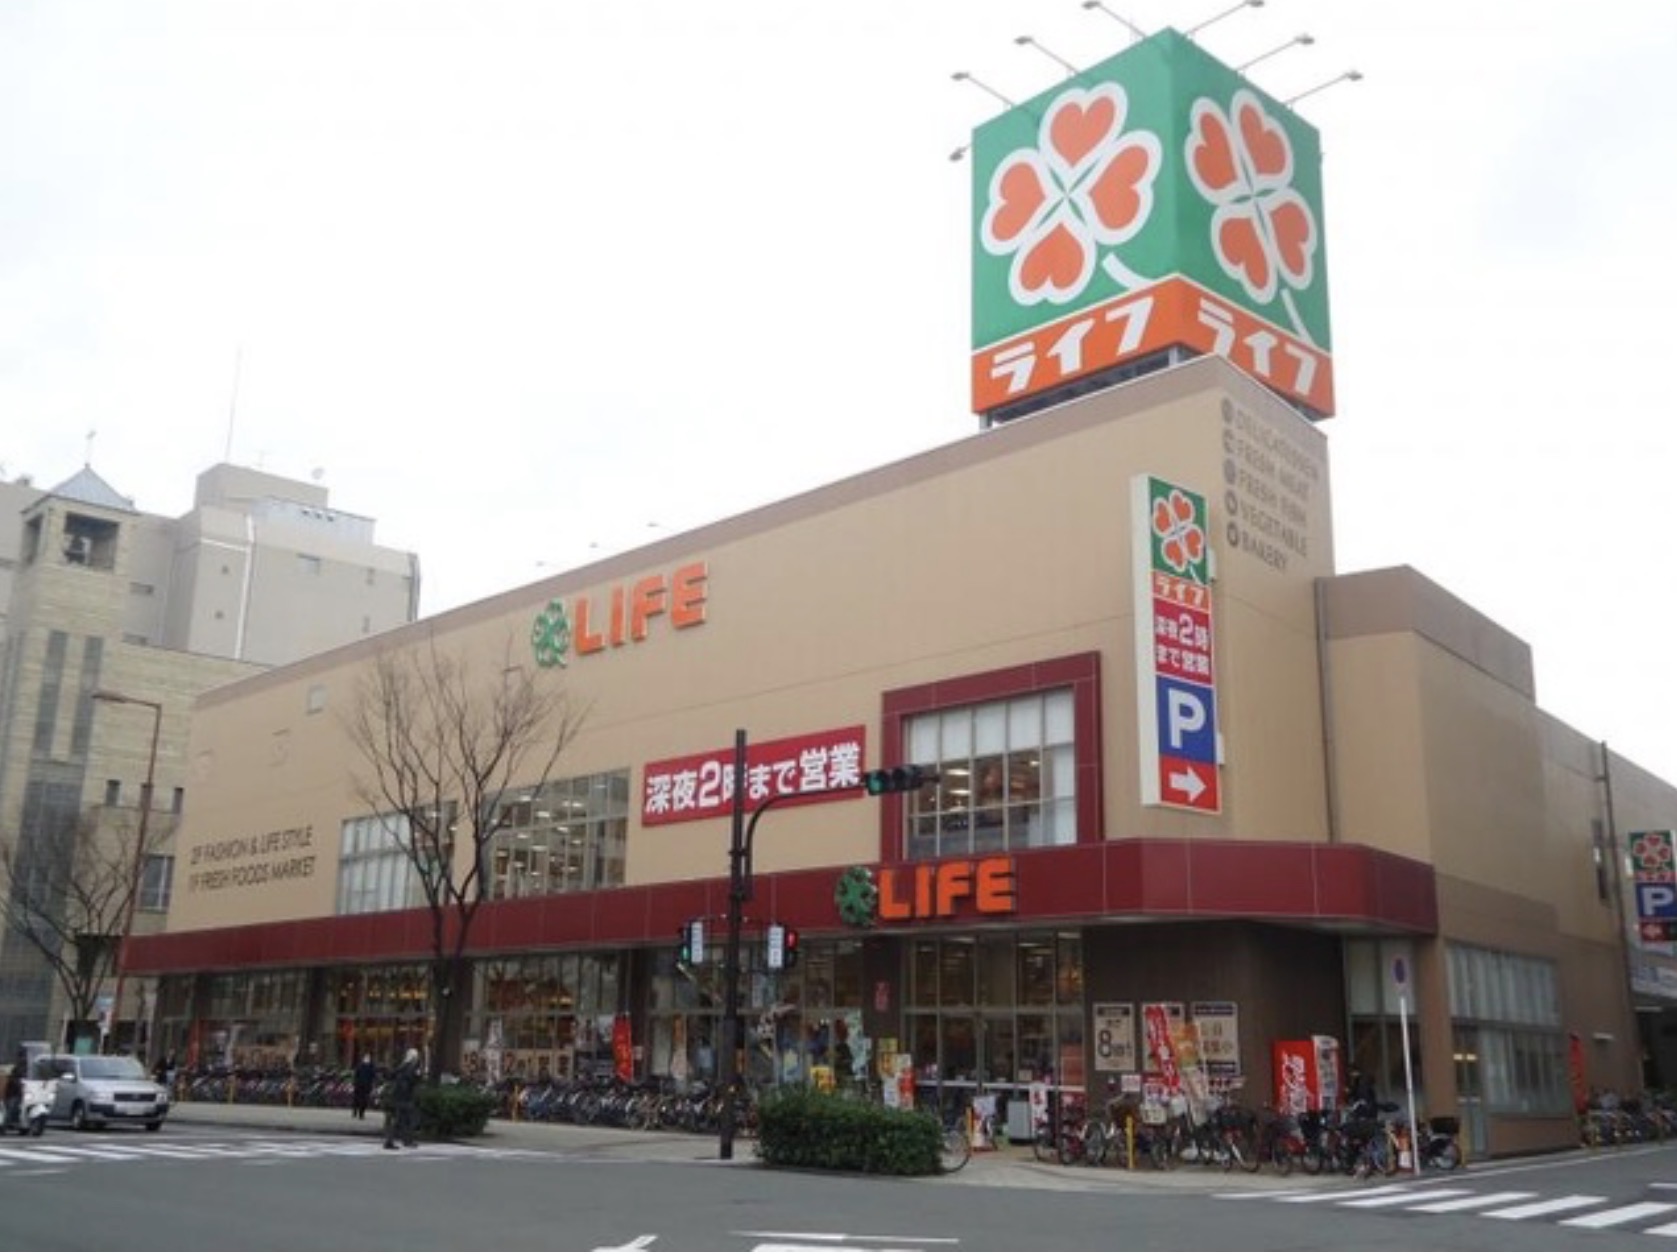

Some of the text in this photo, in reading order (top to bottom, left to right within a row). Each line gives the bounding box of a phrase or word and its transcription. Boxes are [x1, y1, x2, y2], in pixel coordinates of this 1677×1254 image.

[989, 296, 1154, 395] ライフ
[1197, 298, 1318, 396] ライフ
[1241, 529, 1288, 572] BAKERY
[574, 561, 708, 656] LIFE
[1156, 575, 1205, 607] ライフ
[1167, 687, 1206, 750] P
[203, 837, 247, 862] FASHION
[260, 831, 281, 855] LIFE
[281, 823, 313, 851] STYLE
[271, 854, 316, 881] MARKET
[877, 855, 1016, 921] LIFE
[1641, 886, 1675, 916] P
